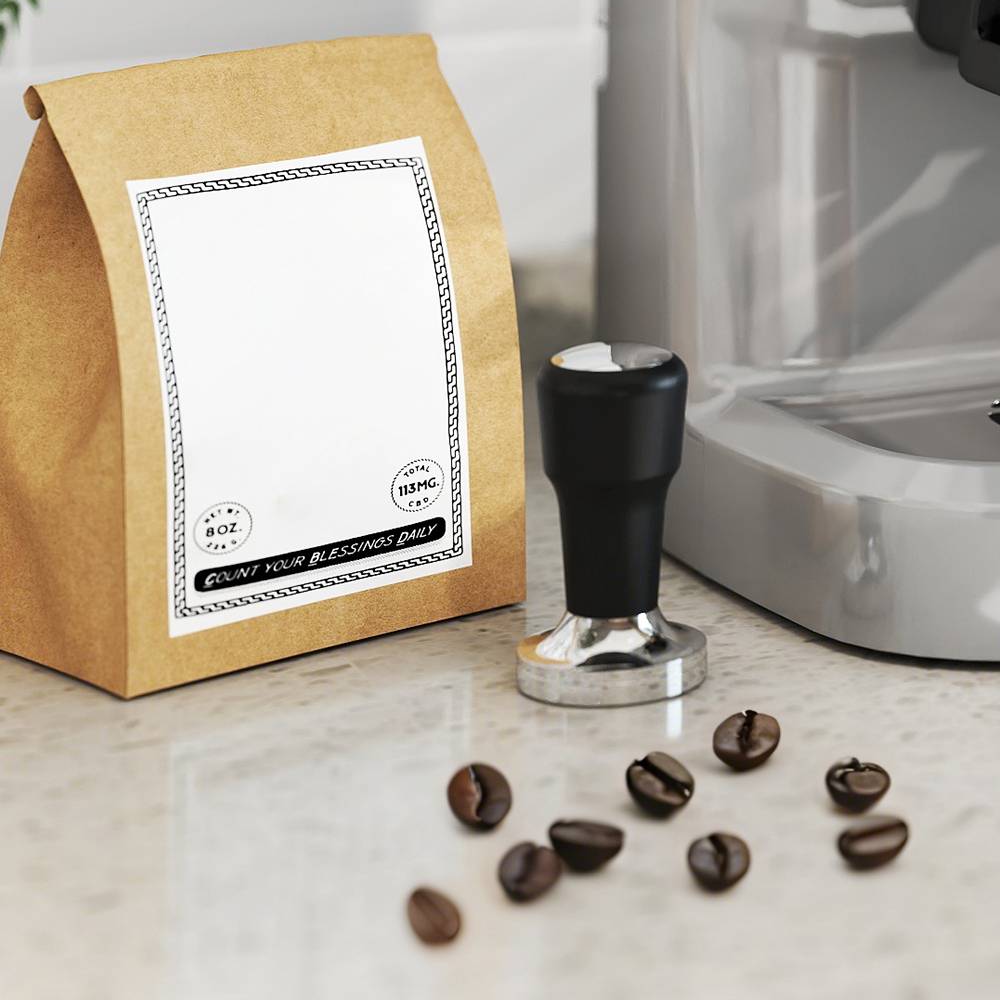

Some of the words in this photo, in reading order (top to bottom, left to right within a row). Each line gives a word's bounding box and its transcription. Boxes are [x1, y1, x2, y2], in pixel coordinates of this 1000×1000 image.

[403, 464, 430, 478] TOTAL
[408, 497, 429, 507] CBD
[203, 564, 261, 588] COUNT
[265, 555, 306, 574] YOUR
[308, 533, 395, 567] BLESSINGS
[395, 523, 438, 547] DAILY
